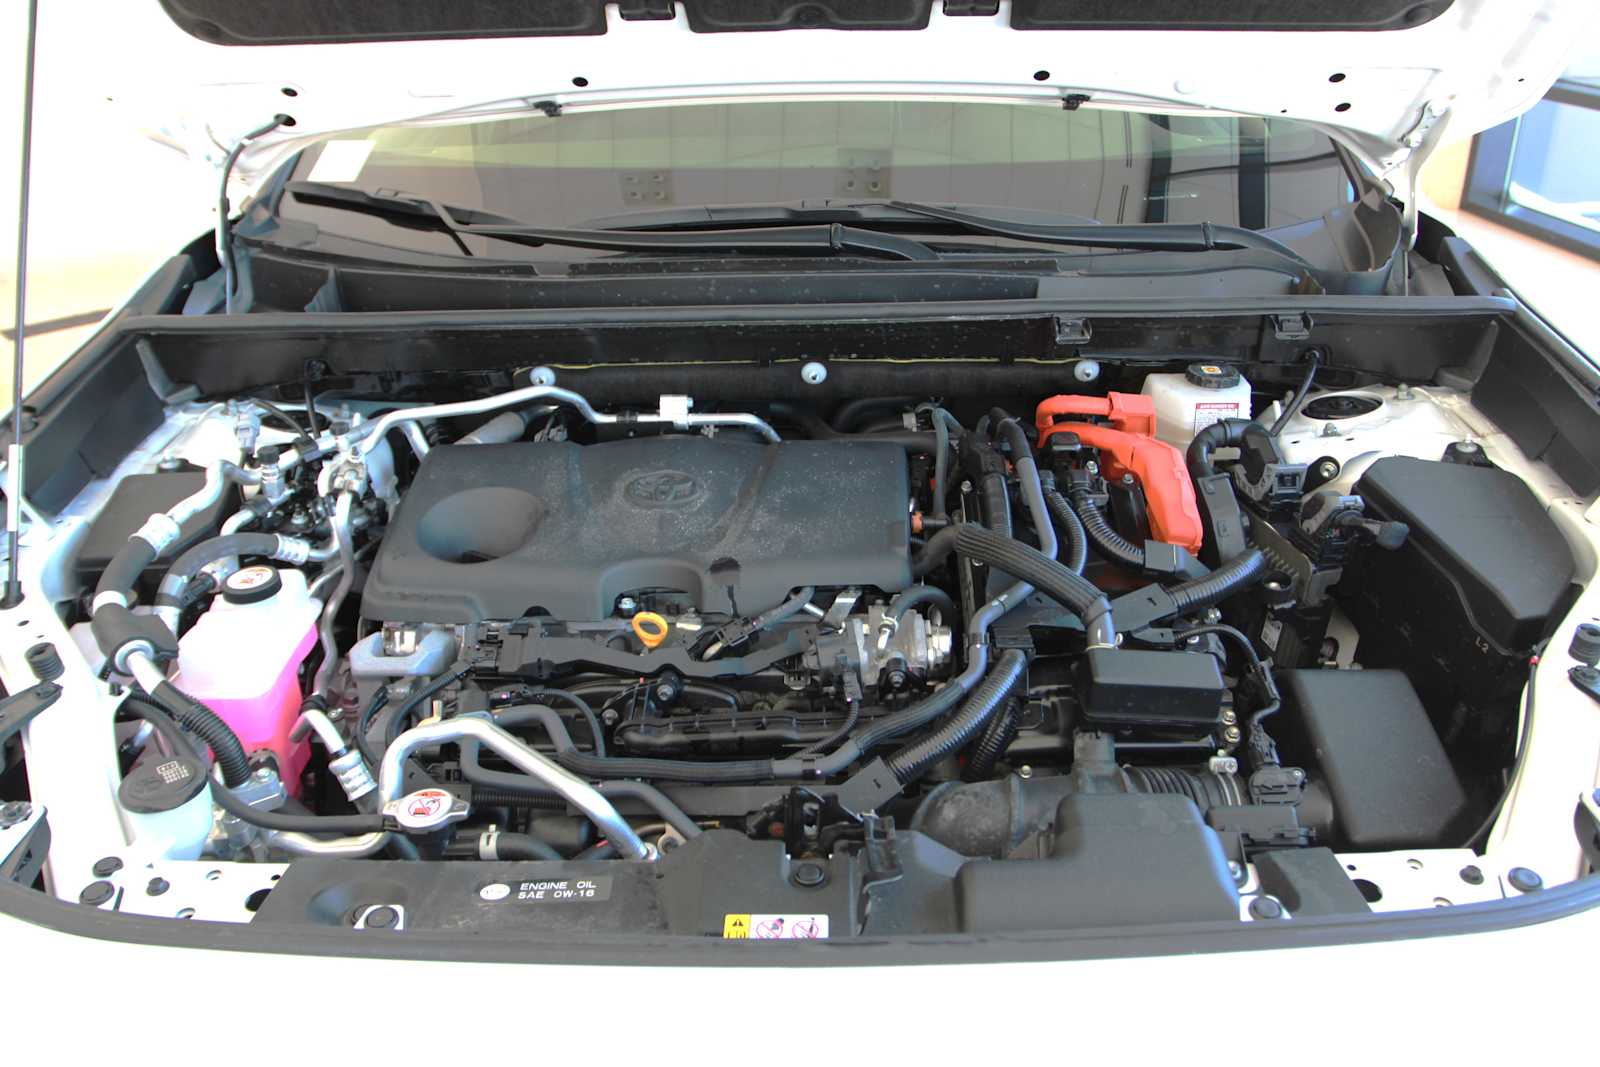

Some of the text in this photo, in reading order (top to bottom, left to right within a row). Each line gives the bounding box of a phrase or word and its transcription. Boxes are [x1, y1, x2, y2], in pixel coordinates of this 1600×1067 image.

[520, 881, 597, 891] ENGINE OIL
[518, 890, 544, 899] SAE
